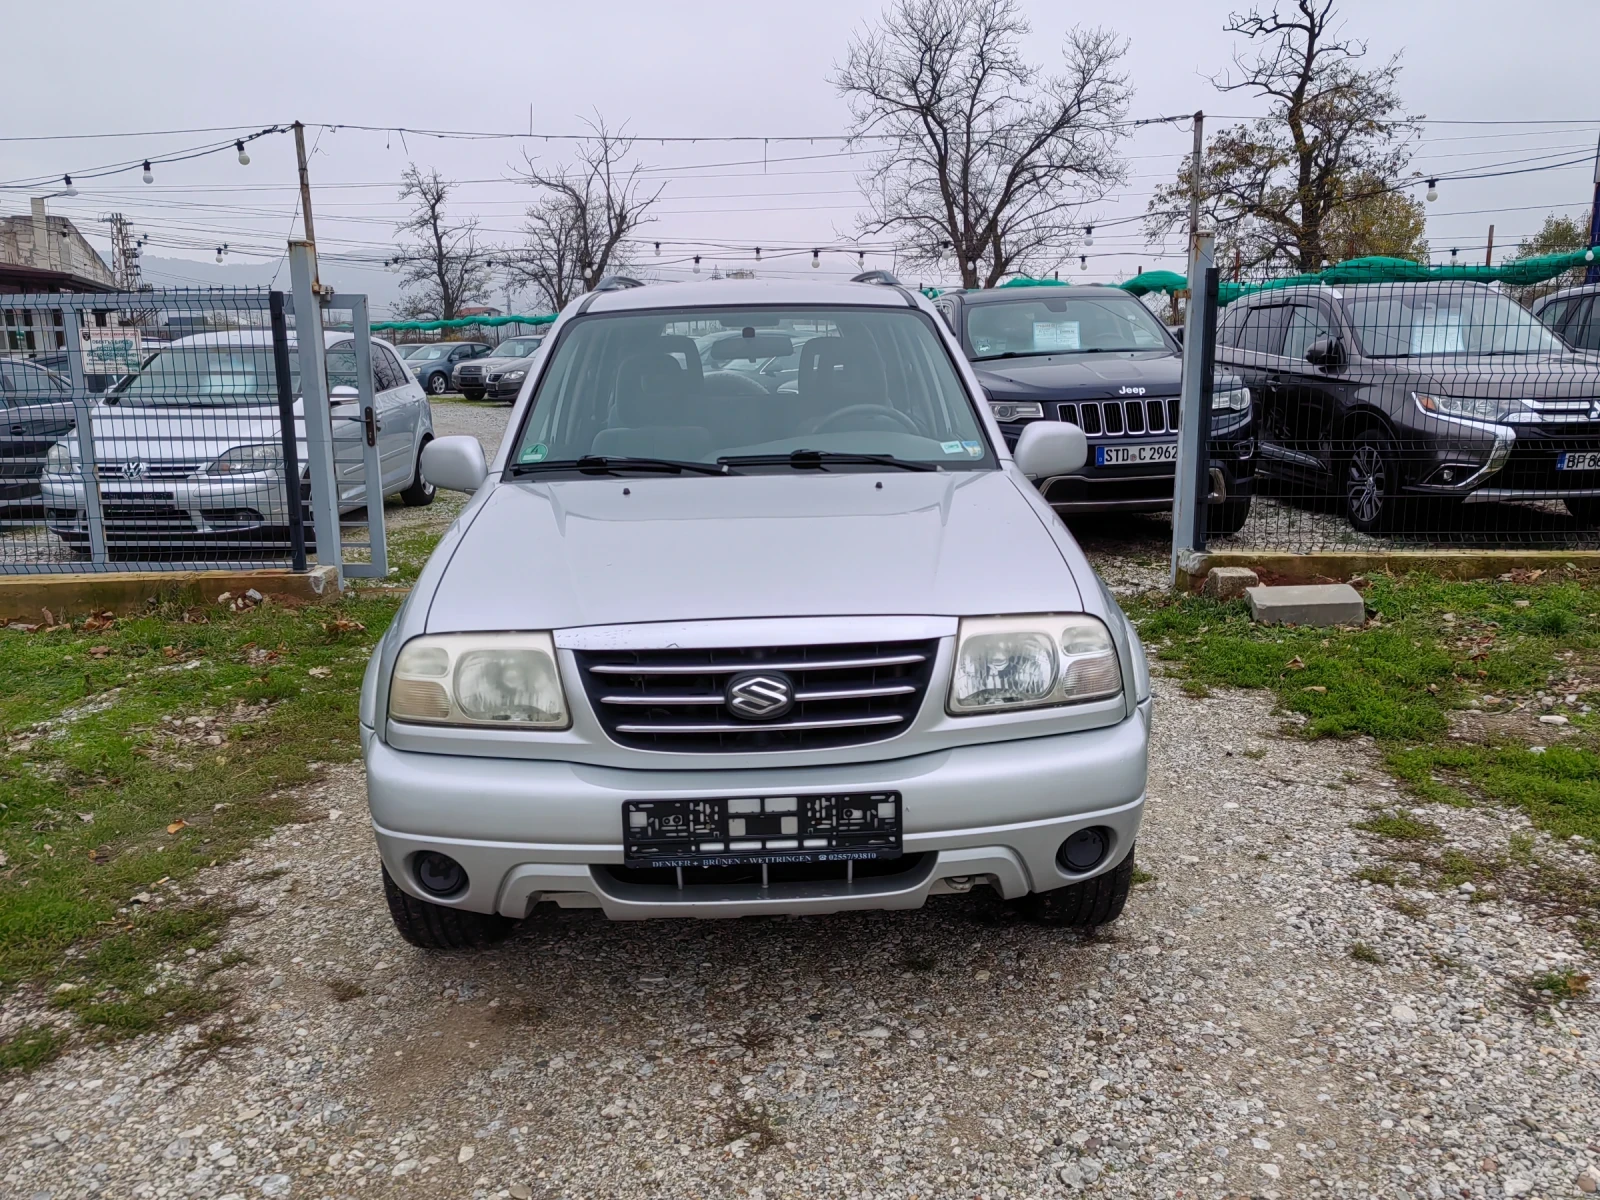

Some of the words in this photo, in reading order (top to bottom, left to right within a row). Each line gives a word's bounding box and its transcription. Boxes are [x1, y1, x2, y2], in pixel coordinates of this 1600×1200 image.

[1118, 386, 1146, 395] Jeep
[1105, 448, 1129, 462] STD
[1138, 448, 1146, 460] C
[1149, 446, 1177, 460] 2962
[702, 858, 741, 866] BRÜNEN
[749, 855, 812, 864] WETTRINGEN
